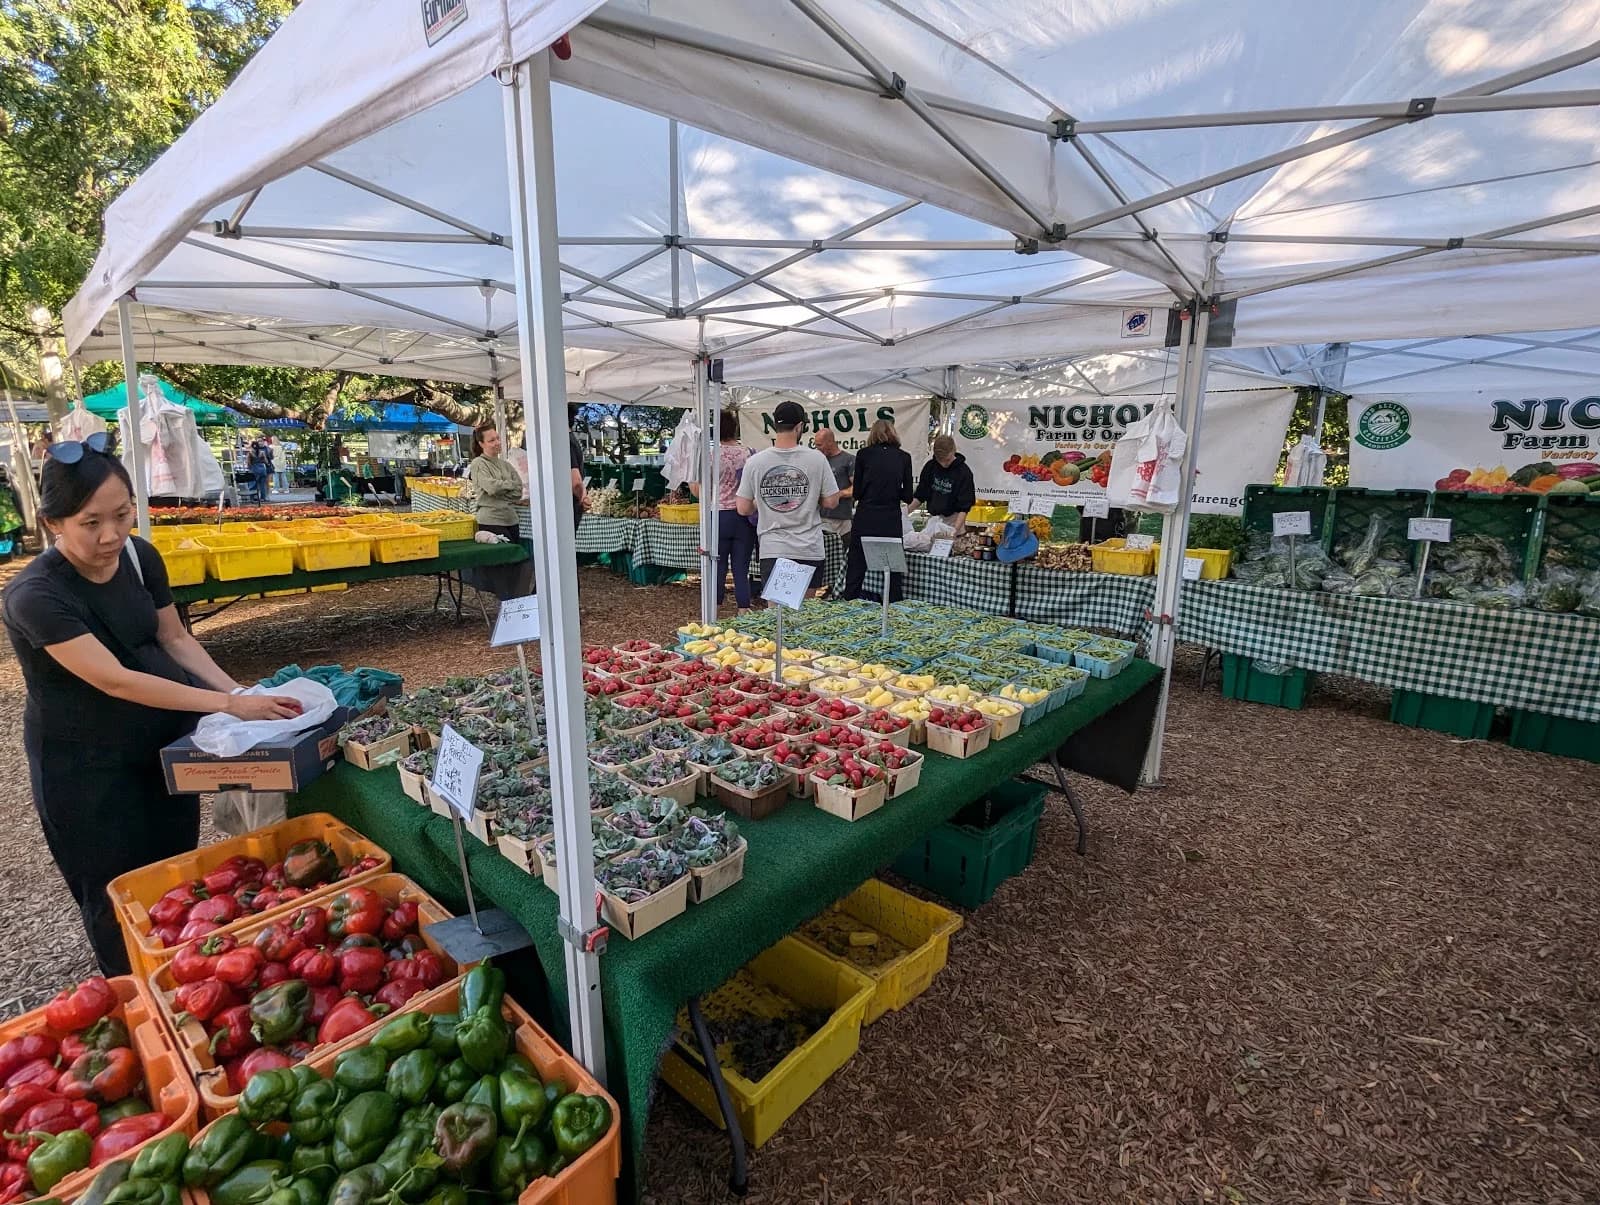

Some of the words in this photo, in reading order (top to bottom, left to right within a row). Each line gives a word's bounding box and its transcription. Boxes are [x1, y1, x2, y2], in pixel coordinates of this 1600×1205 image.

[761, 406, 896, 434] NHOLS
[1035, 428, 1077, 442] Farm
[1083, 428, 1099, 441] &
[1502, 432, 1590, 450] Farm
[1541, 450, 1598, 461] Variety
[762, 487, 790, 497] JACKSON
[791, 486, 808, 496] HOLE
